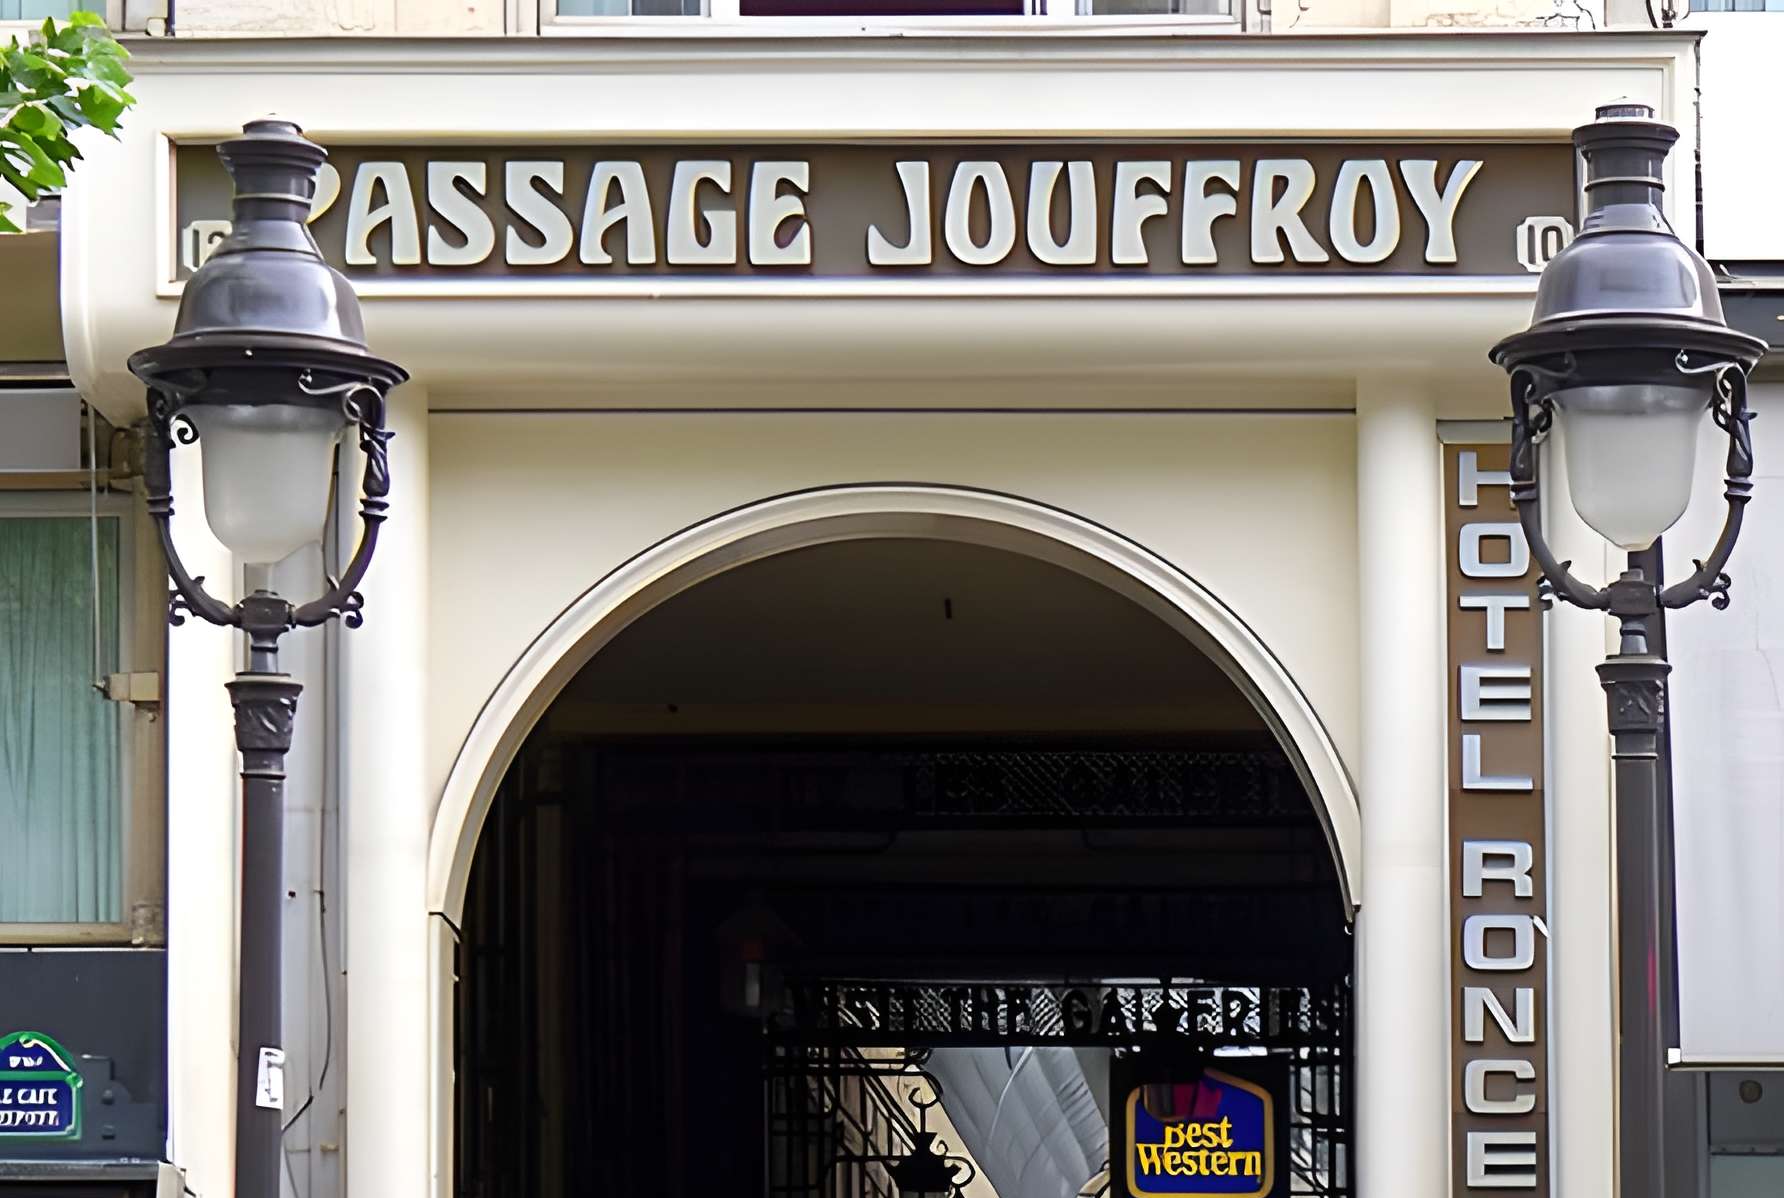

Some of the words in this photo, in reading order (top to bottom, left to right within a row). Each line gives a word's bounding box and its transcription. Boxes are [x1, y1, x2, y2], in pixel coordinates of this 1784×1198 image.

[312, 159, 813, 267] ASSAGE
[867, 159, 1484, 266] JOUFFROY
[1164, 1115, 1233, 1149] Best
[1136, 1143, 1262, 1176] Western
